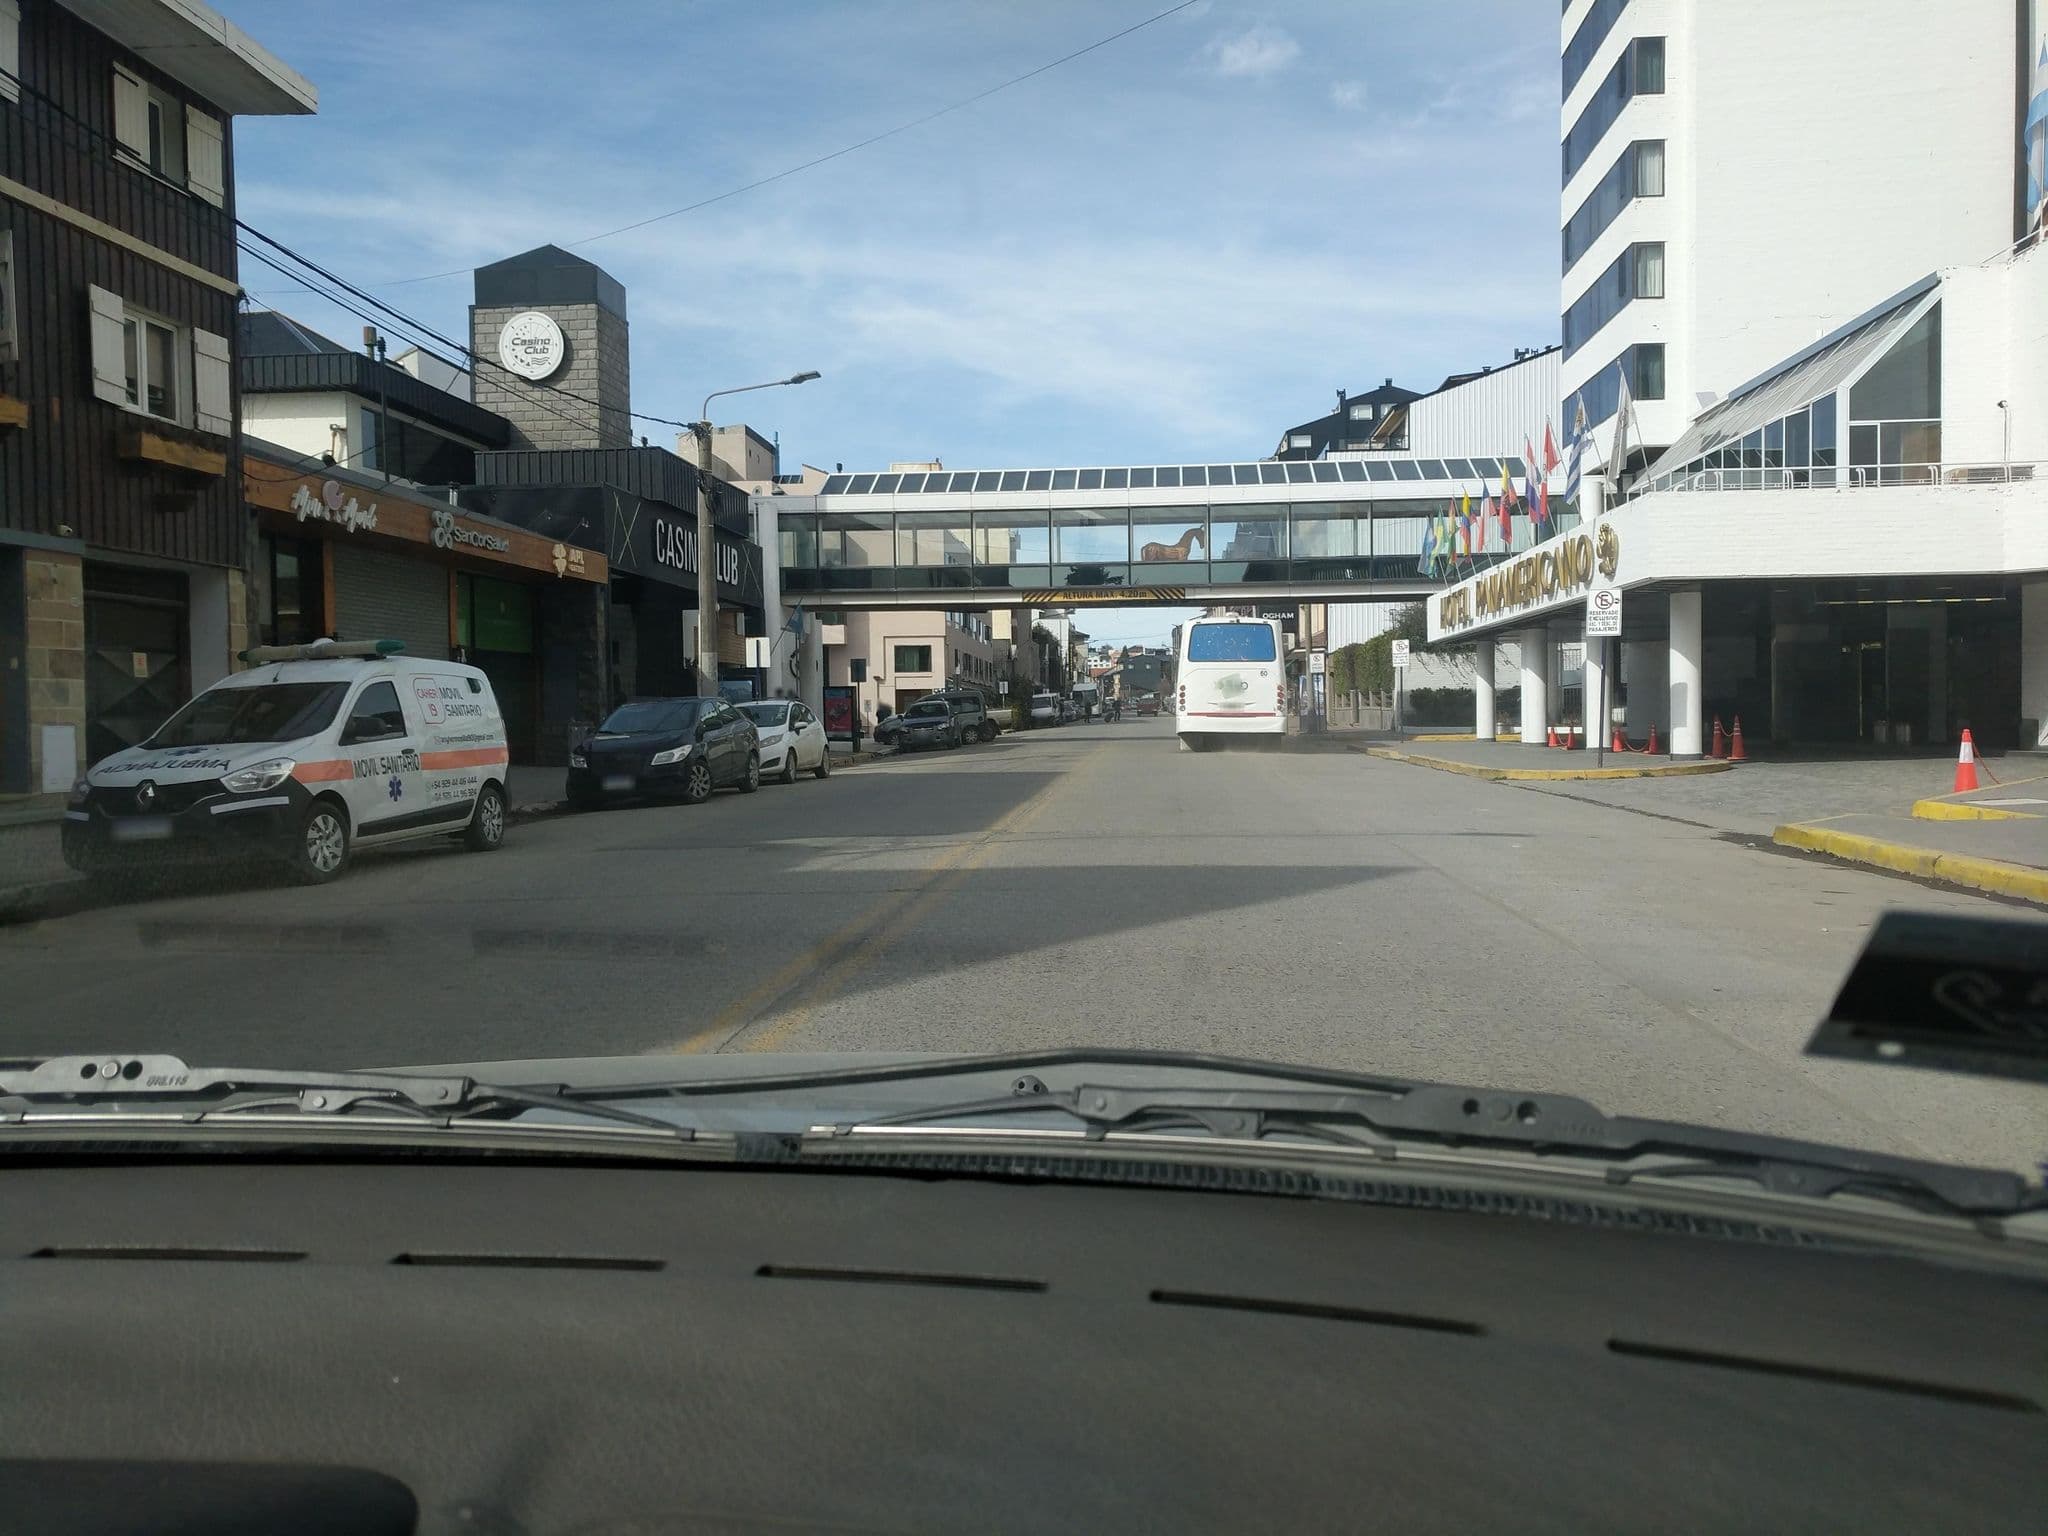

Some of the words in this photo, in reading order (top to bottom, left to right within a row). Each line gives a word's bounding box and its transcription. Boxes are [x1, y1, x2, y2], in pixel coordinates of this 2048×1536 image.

[511, 336, 551, 346] Casino
[524, 346, 549, 355] Club
[656, 518, 698, 574] CASIN
[714, 541, 739, 586] LUB
[1440, 586, 1469, 630] HOTEL
[1475, 533, 1594, 618] PANAMERICANO
[1063, 591, 1093, 600] ALTURA
[445, 704, 482, 717] SANITARIO
[353, 757, 380, 779] MOVIL
[380, 753, 420, 775] SANITARIO
